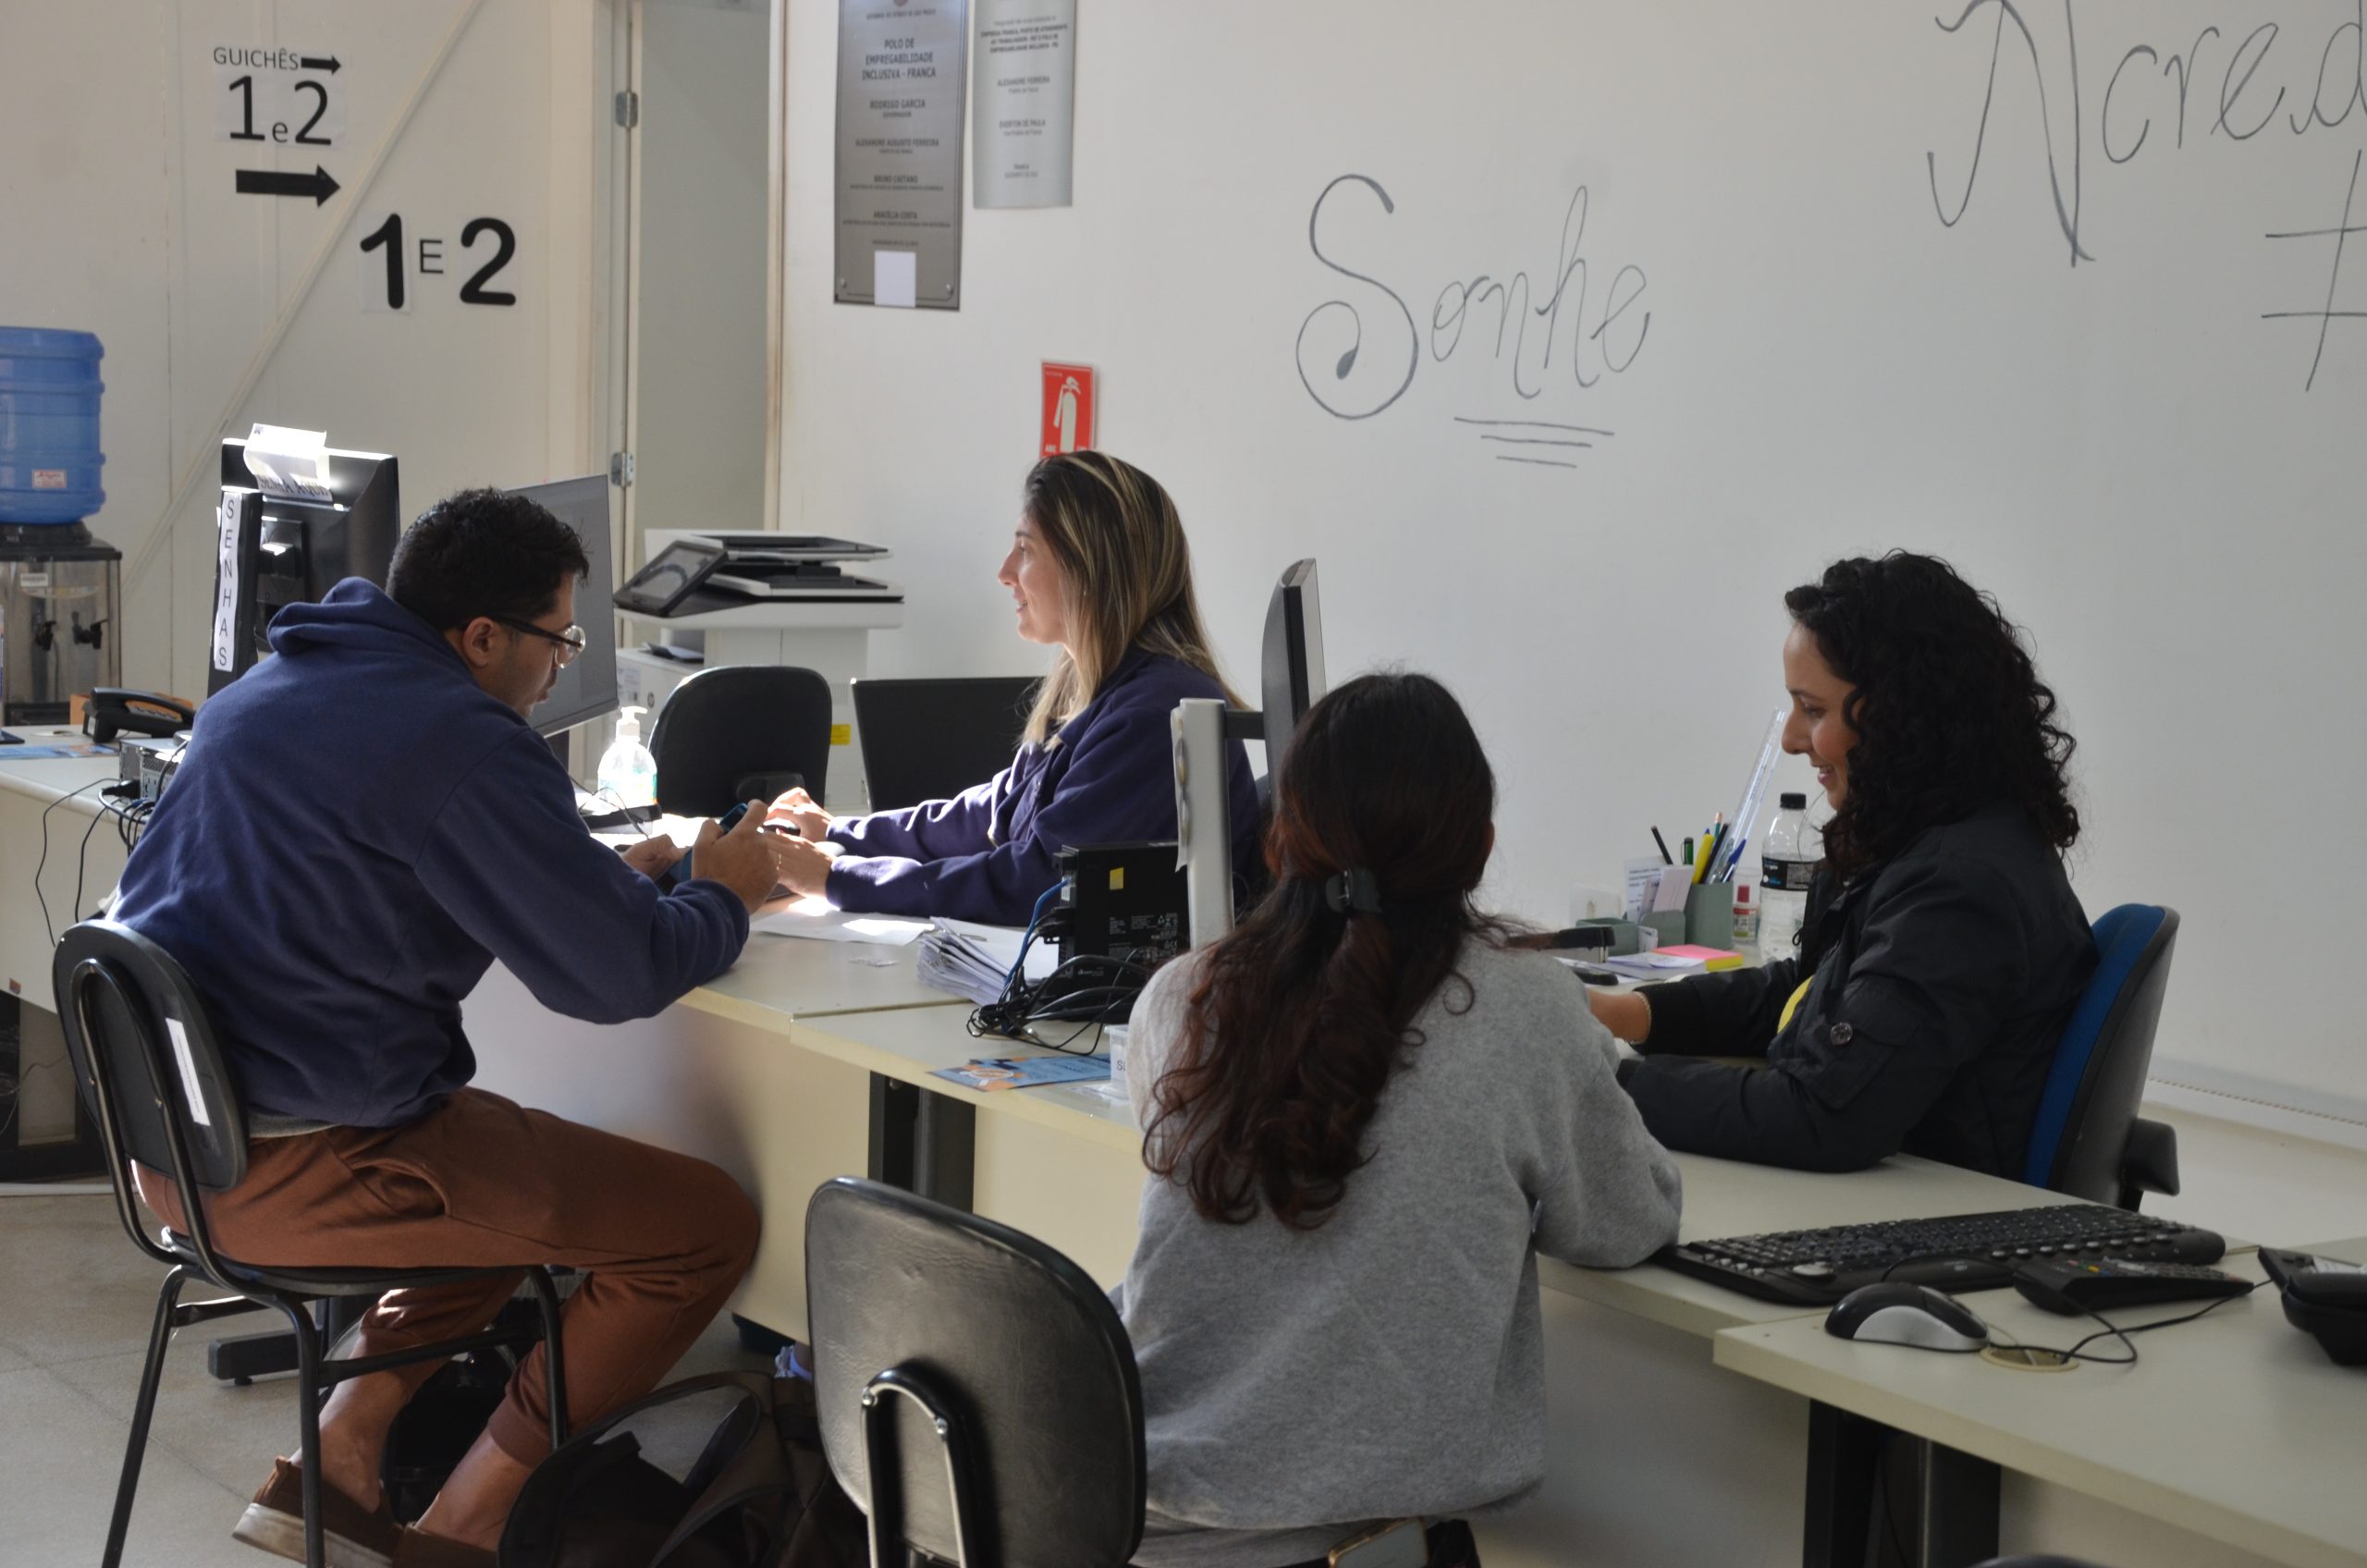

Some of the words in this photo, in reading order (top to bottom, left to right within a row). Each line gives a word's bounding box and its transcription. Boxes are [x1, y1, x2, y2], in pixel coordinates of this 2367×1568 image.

[884, 38, 904, 49] POLO
[905, 37, 914, 49] DE
[213, 47, 299, 71] GUICHÊS
[865, 52, 934, 66] EMPREGABILIDADE
[862, 68, 901, 80] INCLUSIVA
[360, 213, 405, 309] 1
[419, 239, 444, 275] E
[460, 217, 516, 306] 2
[1295, 173, 1650, 421] Sonhe
[218, 499, 235, 667] SENHAS
